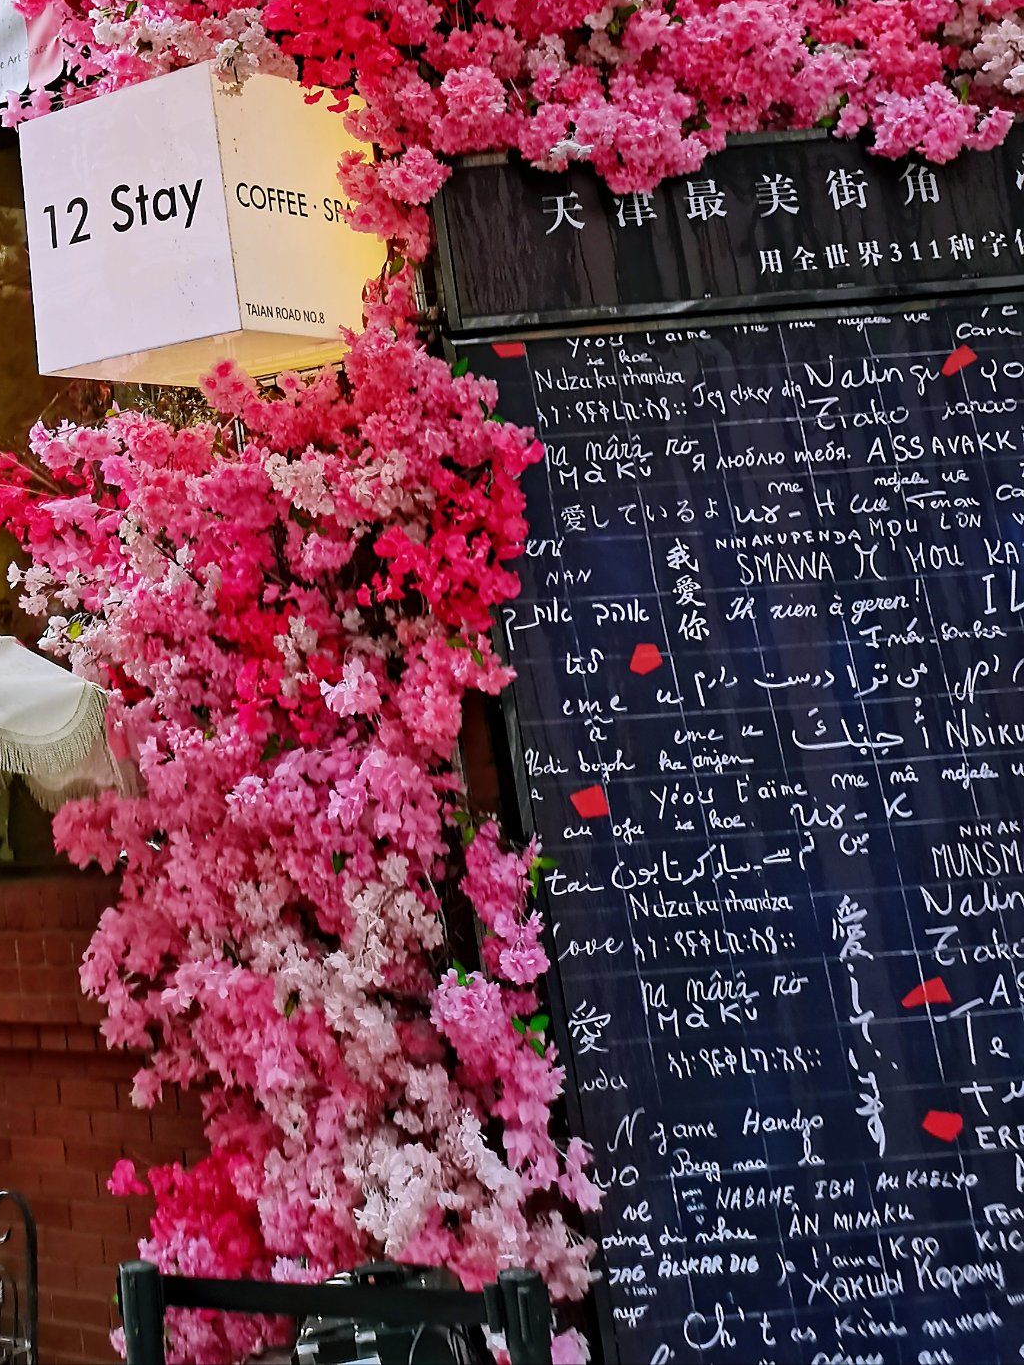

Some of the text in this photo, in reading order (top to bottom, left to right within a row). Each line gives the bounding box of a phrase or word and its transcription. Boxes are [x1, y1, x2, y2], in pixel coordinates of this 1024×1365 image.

[43, 178, 203, 249] 12 Stay
[236, 182, 309, 218] COFFEE
[245, 303, 326, 324] TAIAN ROAD NO.8
[692, 380, 806, 414] Jeg elsker dig
[716, 446, 785, 470] люблю
[561, 498, 720, 532] 愛しているよ
